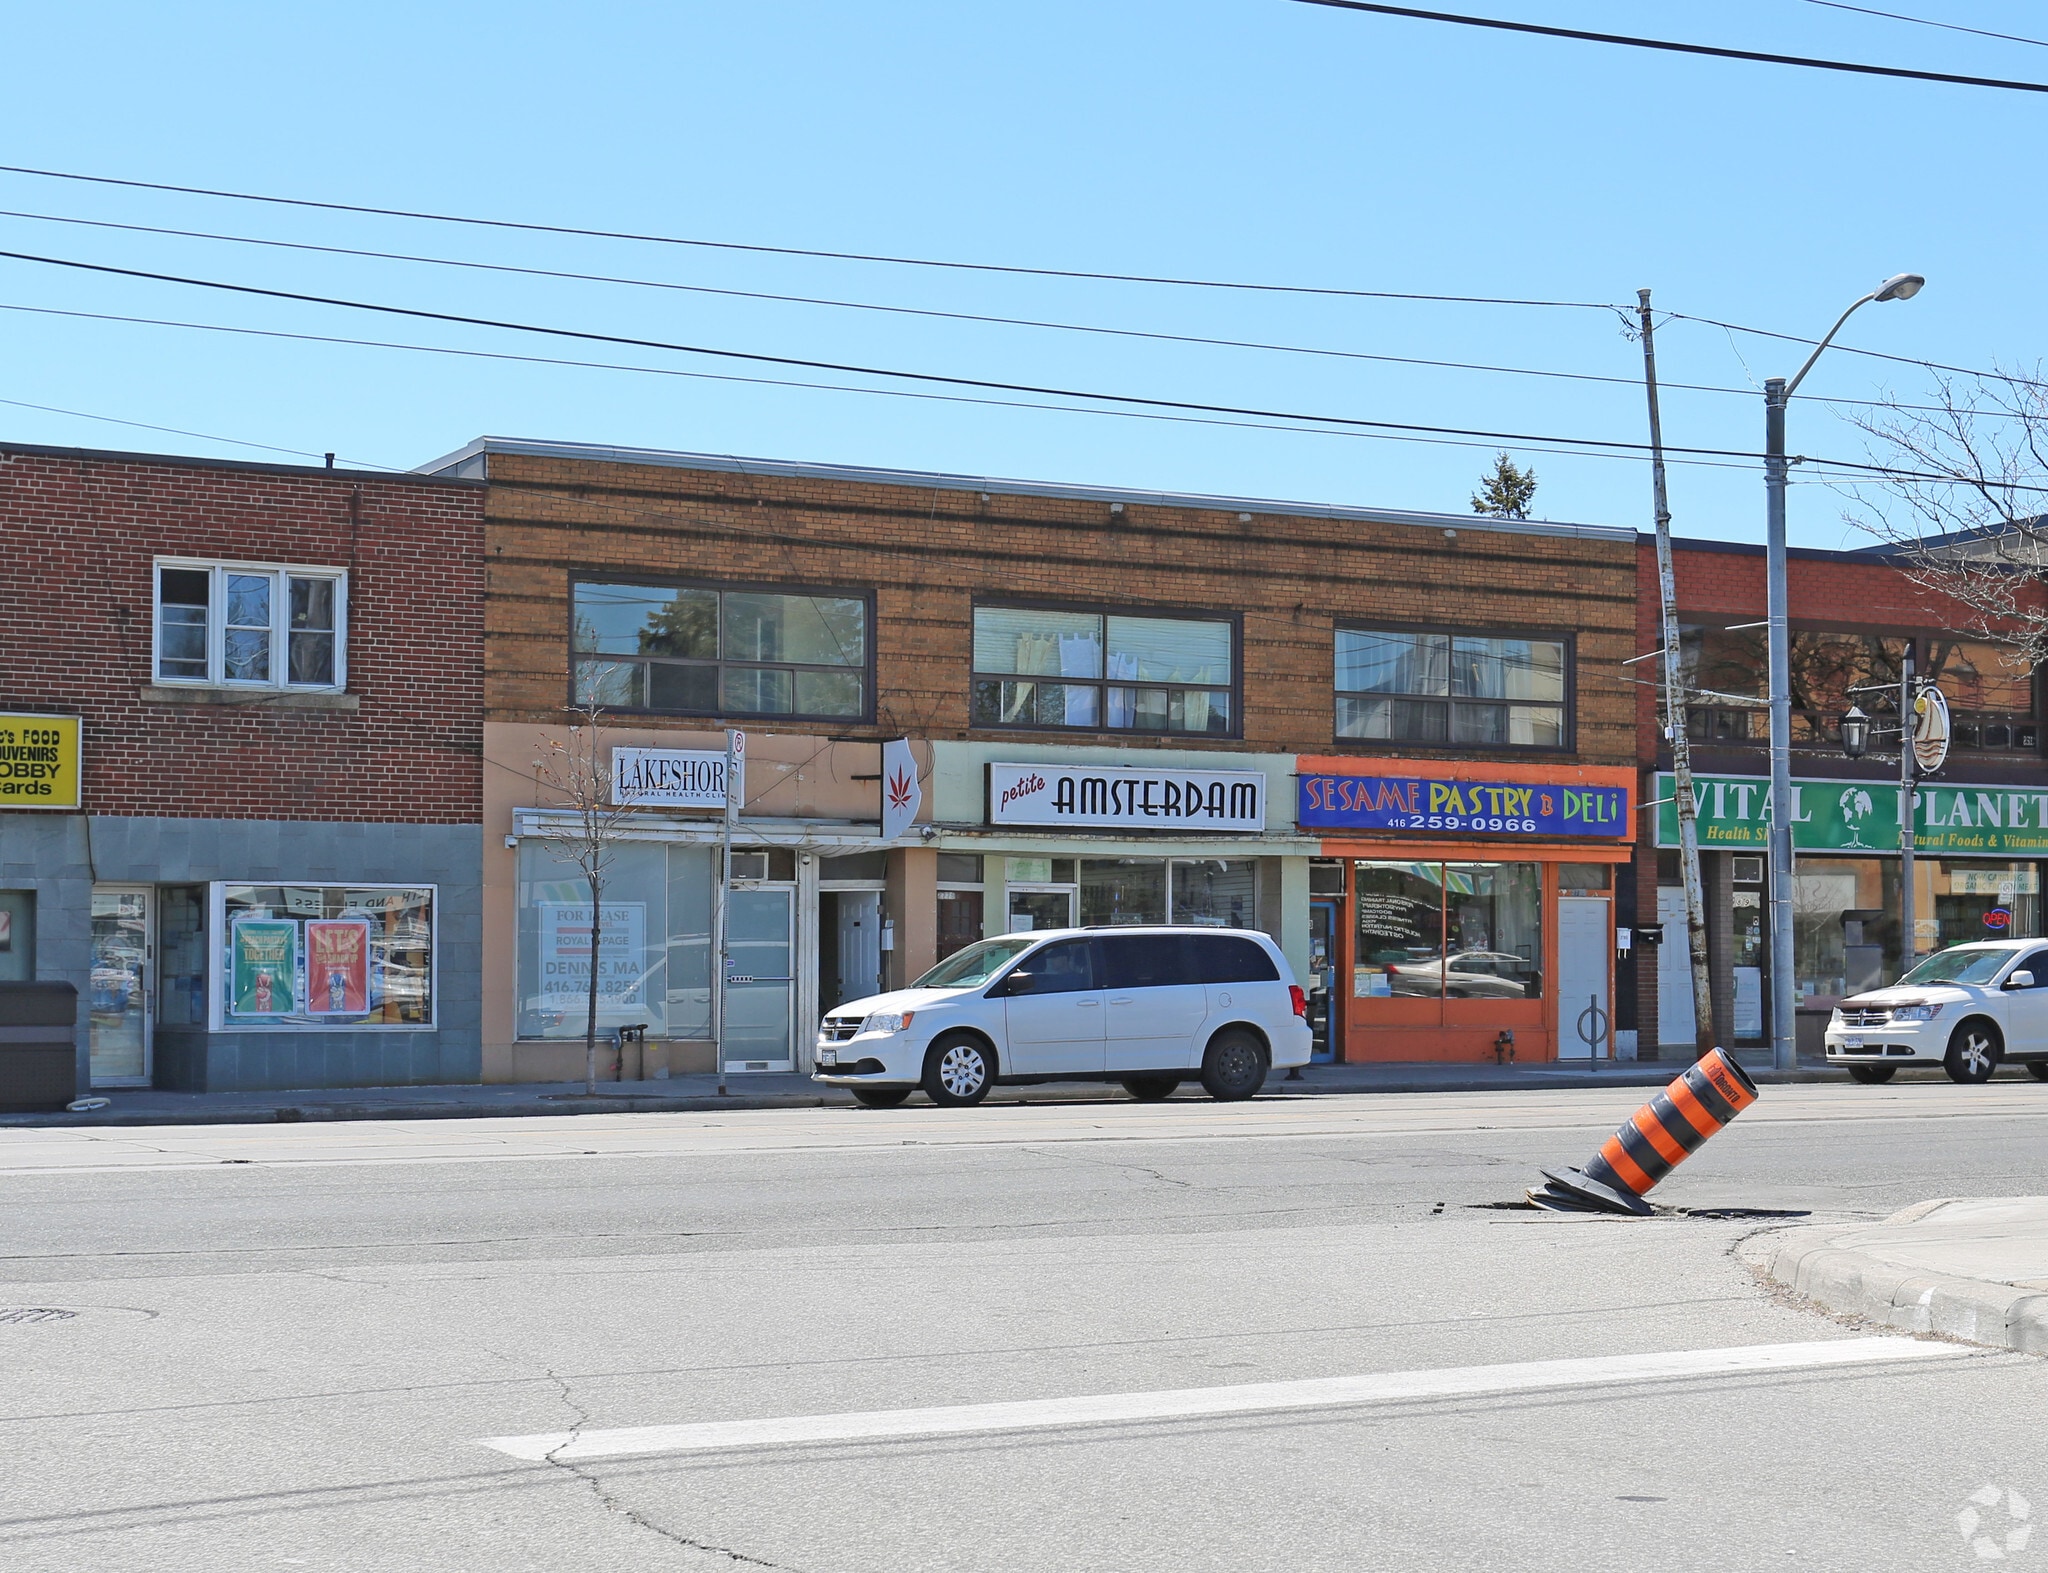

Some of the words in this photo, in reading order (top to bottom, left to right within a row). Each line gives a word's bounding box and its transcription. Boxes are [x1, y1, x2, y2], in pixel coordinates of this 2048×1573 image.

[23, 730, 60, 746] FOOD
[0, 762, 61, 778] OBBY
[618, 758, 738, 793] LAKESHOR
[0, 780, 52, 796] ards
[1000, 773, 1046, 812] petite
[1051, 776, 1256, 819] AMSTERDAM
[1305, 778, 1420, 814] SESAME
[1429, 782, 1533, 818] PASTRY
[1895, 790, 2048, 829] PLANET
[1387, 818, 1406, 829] 416
[1409, 815, 1537, 832] 259-0966
[1706, 825, 1750, 840] Health
[1897, 832, 1944, 847] tural
[1948, 833, 1984, 847] Foods
[1988, 835, 1997, 847] &
[2003, 834, 2048, 848] Vitamin
[556, 910, 585, 921] FOR
[1982, 912, 2010, 925] OPEN
[556, 936, 589, 945] ROYAL
[598, 936, 629, 945] PAGE
[546, 961, 607, 975] DENNS
[613, 961, 640, 975] MA
[544, 980, 640, 993] 416.76.8255
[1713, 1071, 1741, 1103] TORONTO
